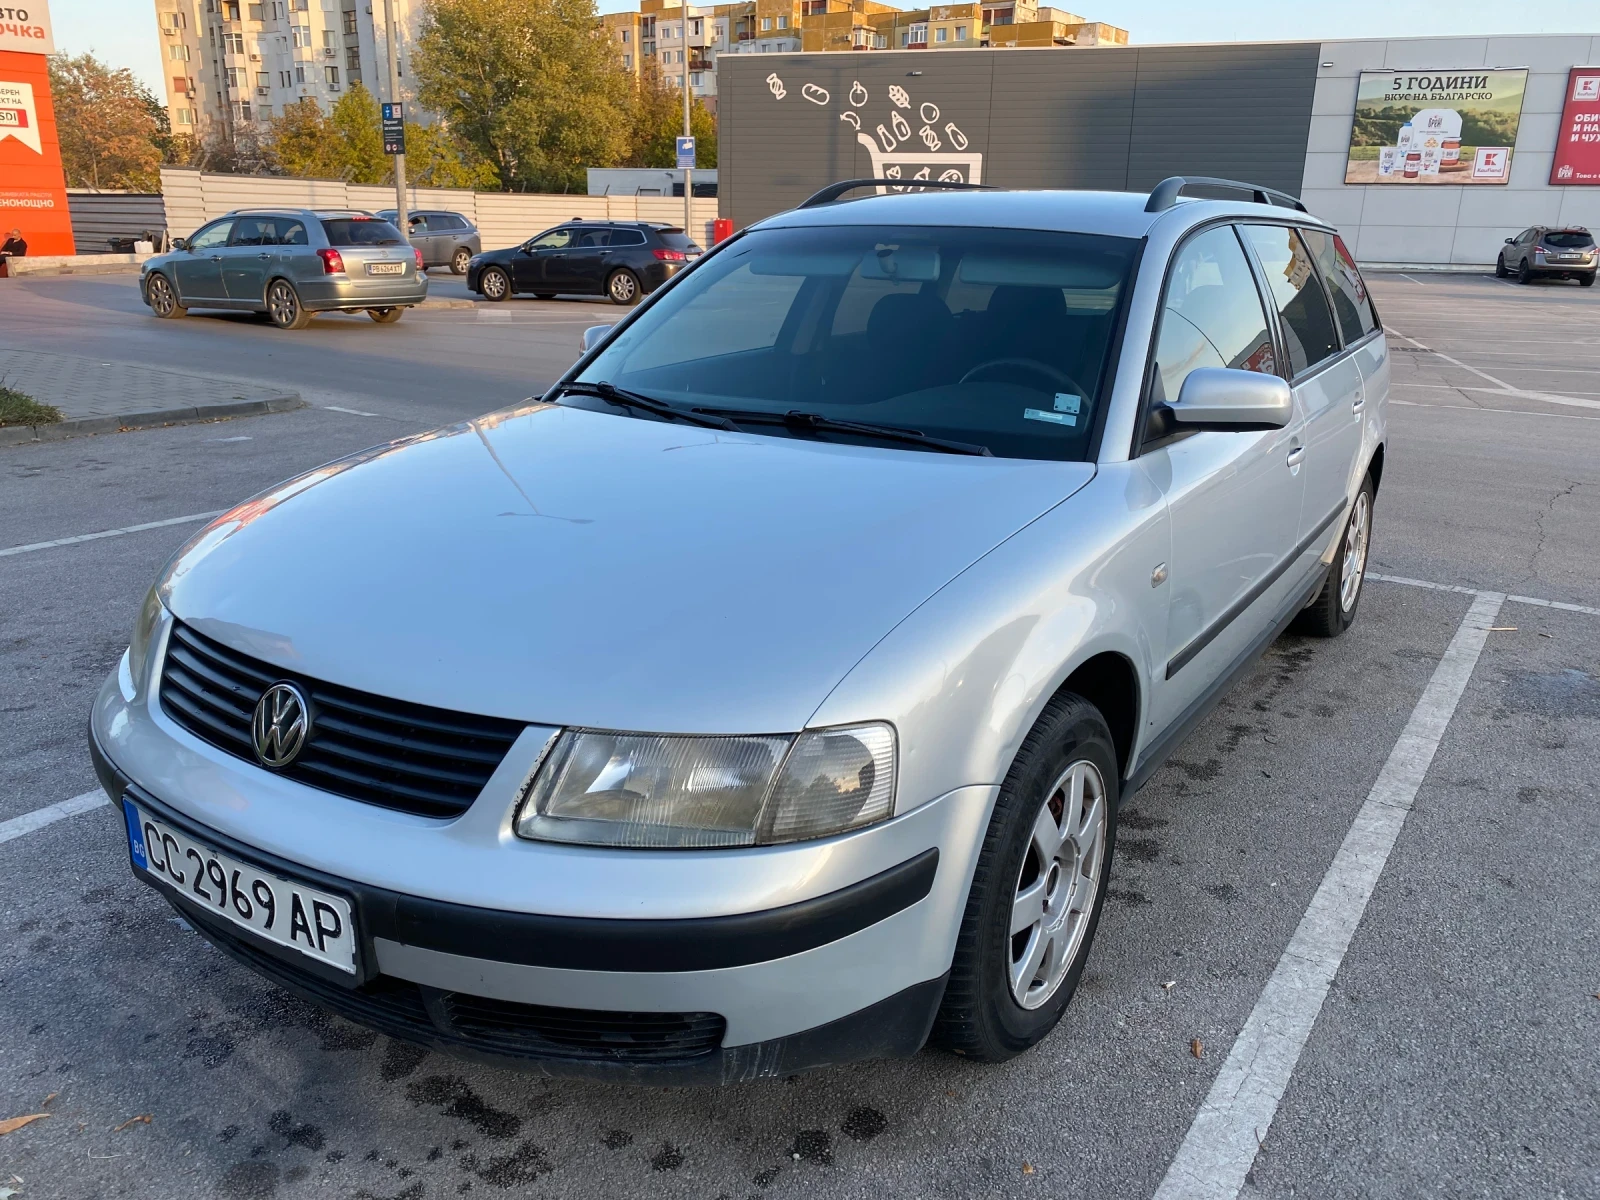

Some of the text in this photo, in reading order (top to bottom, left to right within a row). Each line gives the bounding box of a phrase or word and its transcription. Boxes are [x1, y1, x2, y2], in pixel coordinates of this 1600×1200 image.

[1392, 75, 1489, 92] 5 ГОДИНИ
[0, 88, 20, 96] ЕРЕН
[1384, 92, 1493, 101] ВКУС НА БЪЛГАРСКО
[1575, 113, 1600, 122] ОБИ
[1572, 123, 1600, 132] И НА
[1571, 133, 1580, 142] И
[133, 838, 145, 858] BG
[144, 820, 343, 952] CC 2969 AP
